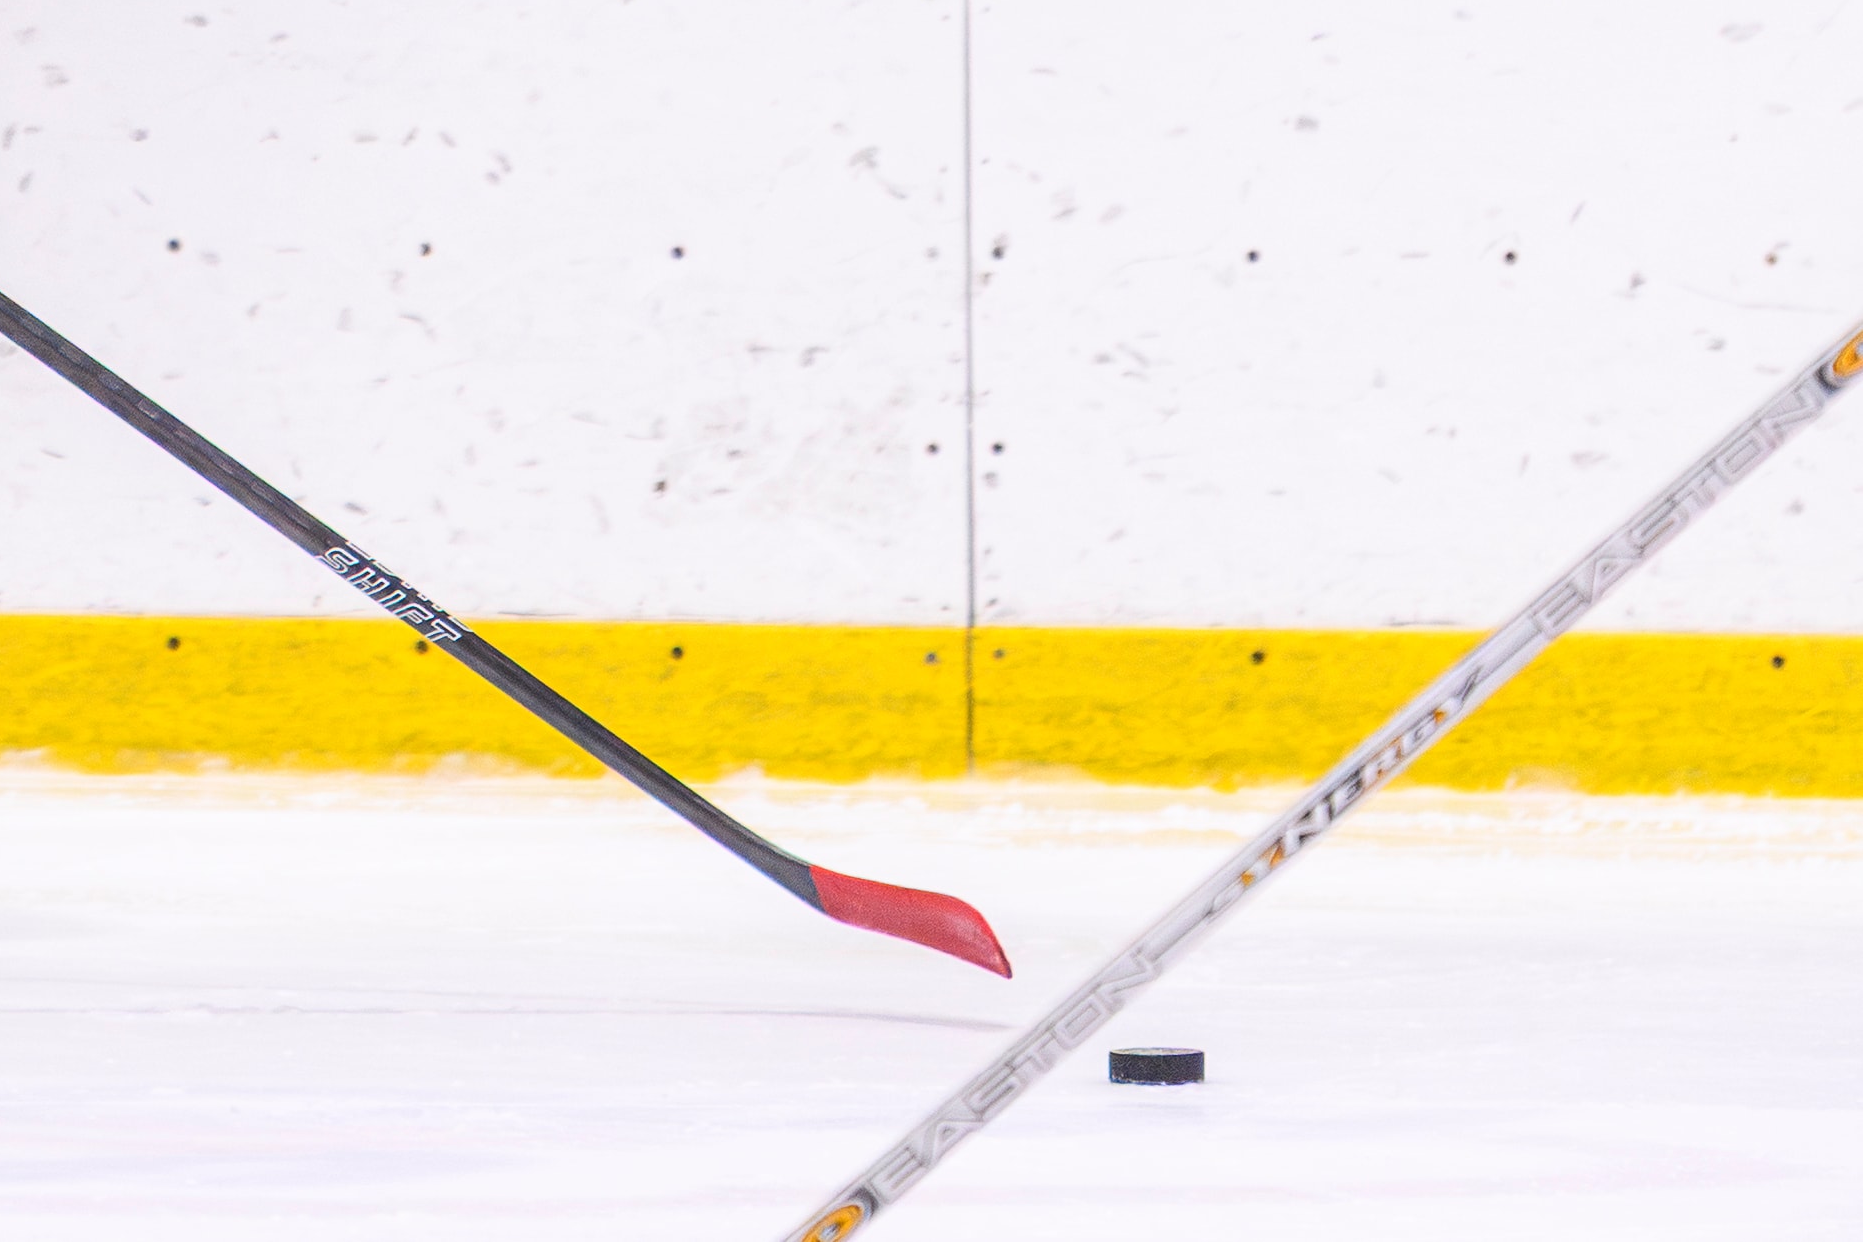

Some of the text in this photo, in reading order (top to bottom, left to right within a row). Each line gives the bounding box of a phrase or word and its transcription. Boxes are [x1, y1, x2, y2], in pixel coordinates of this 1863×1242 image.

[316, 546, 463, 642] SHIFT
[1530, 378, 1827, 640] EASTON
[866, 952, 1162, 1204] EASTON
